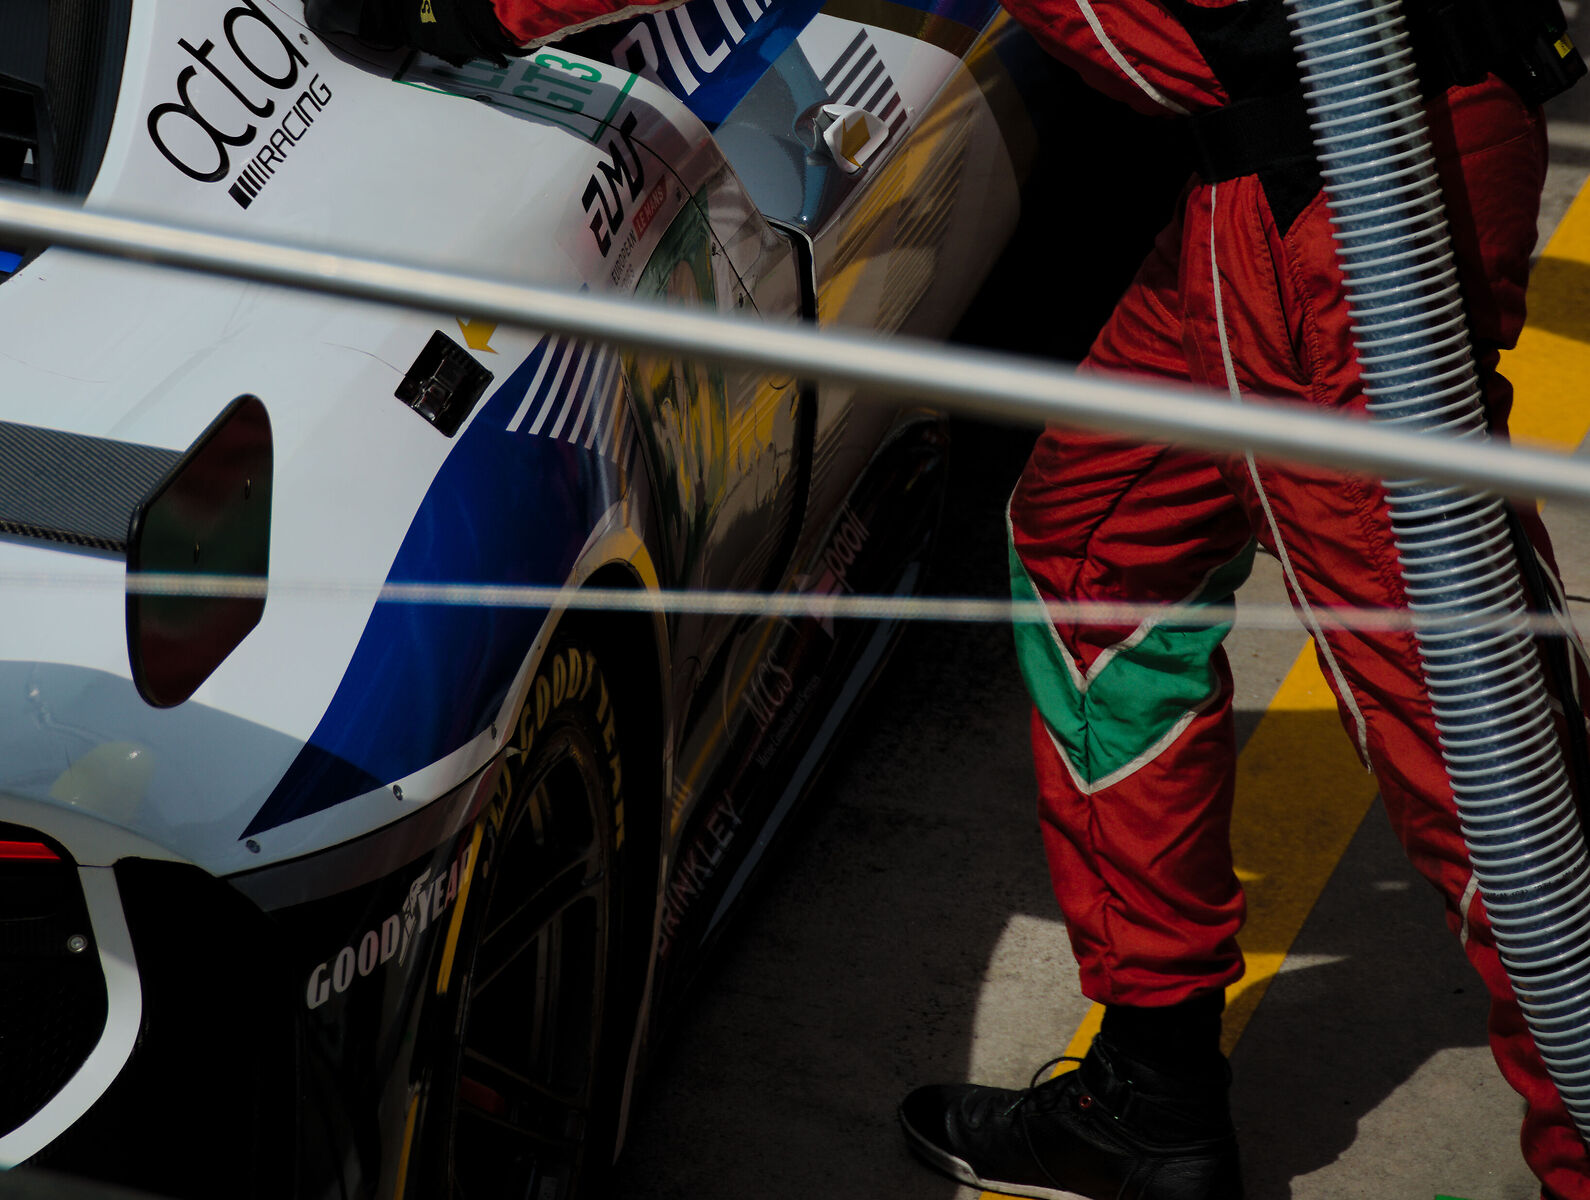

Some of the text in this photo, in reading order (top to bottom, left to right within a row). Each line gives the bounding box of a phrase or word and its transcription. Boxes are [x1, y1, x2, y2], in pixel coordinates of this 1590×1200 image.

[256, 73, 332, 174] RACING
[513, 54, 602, 115] GT3
[611, 230, 638, 285] EUROPEAN
[741, 650, 794, 734] MCS
[306, 842, 474, 1010] GOODYEAR
